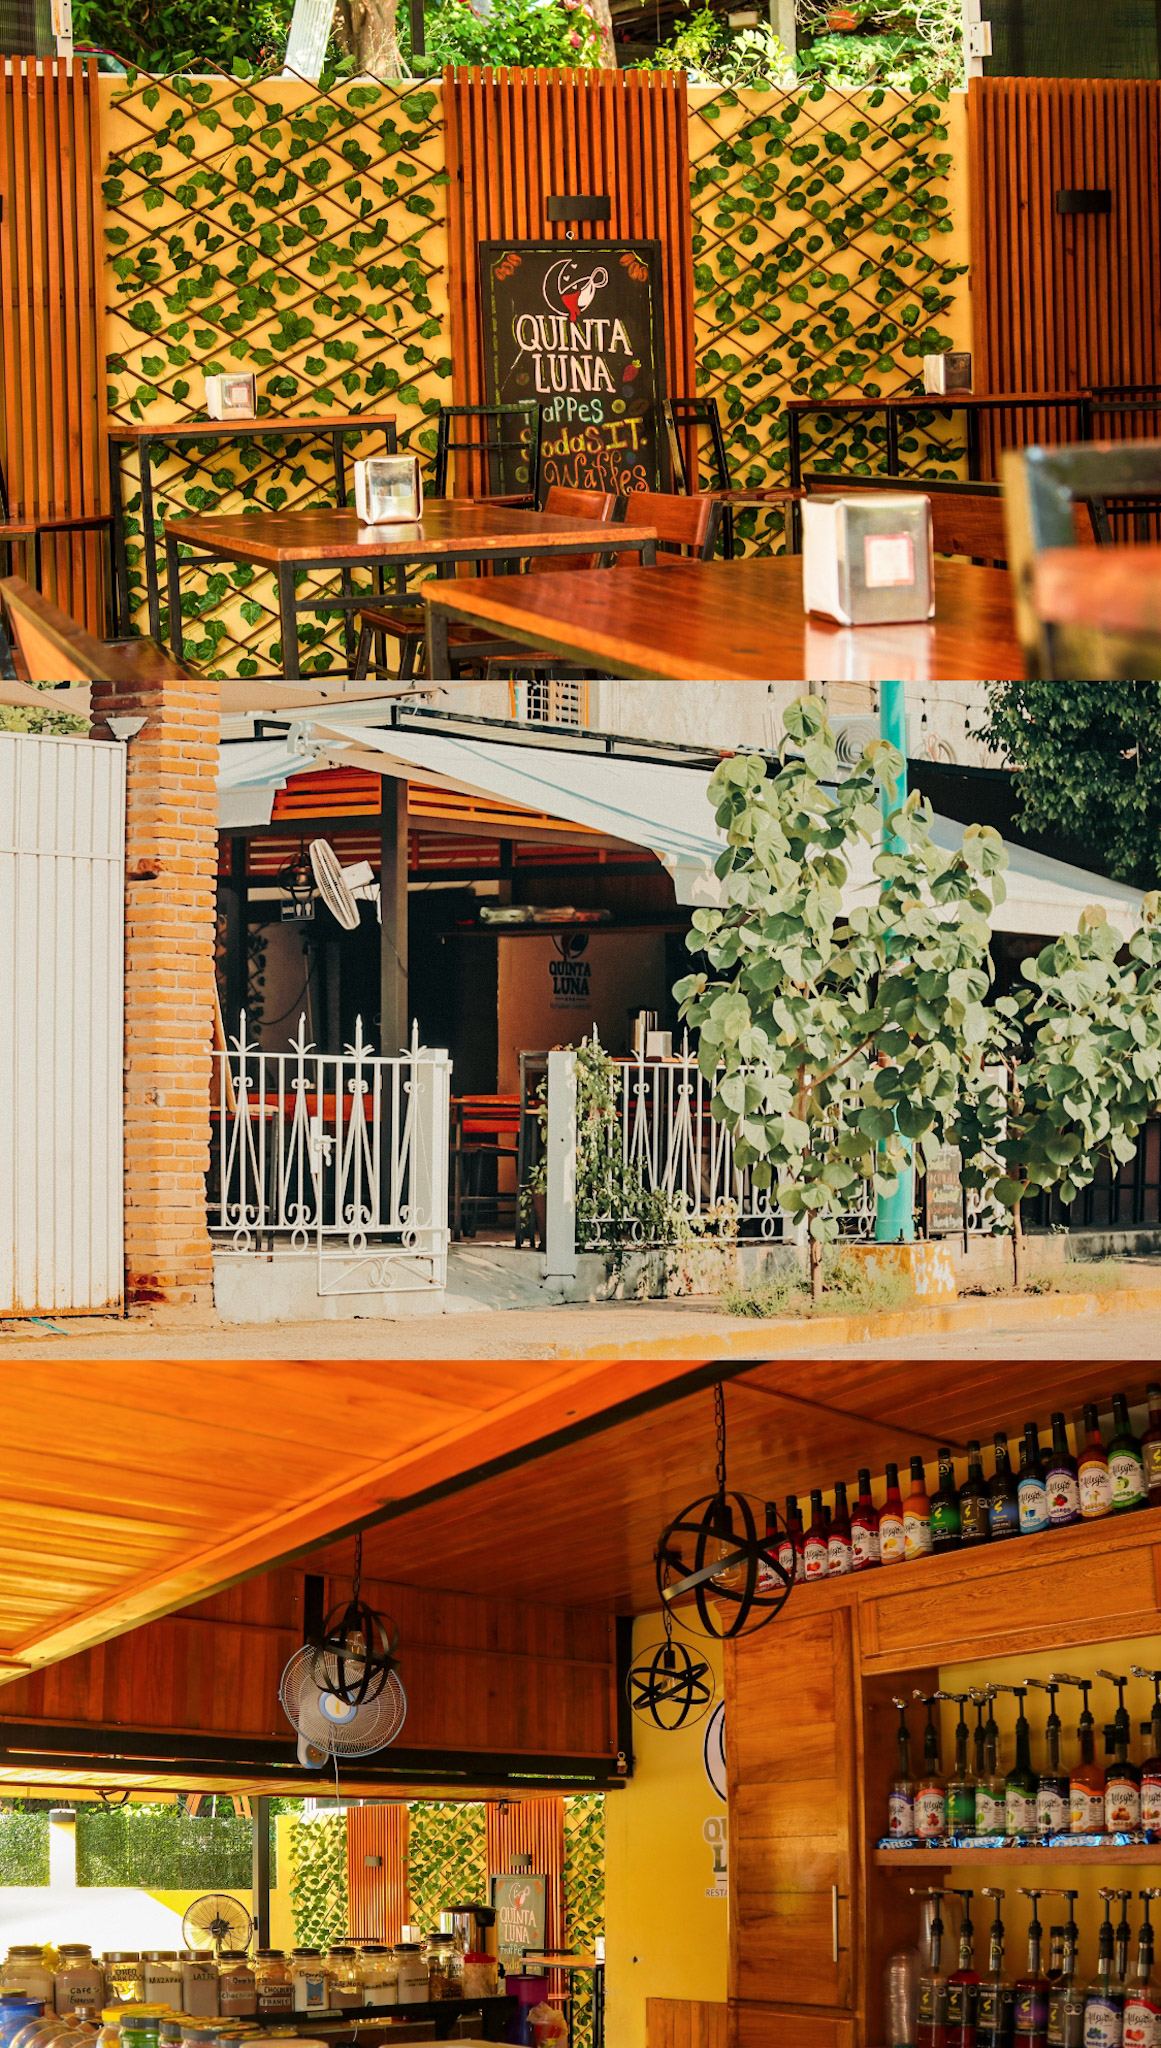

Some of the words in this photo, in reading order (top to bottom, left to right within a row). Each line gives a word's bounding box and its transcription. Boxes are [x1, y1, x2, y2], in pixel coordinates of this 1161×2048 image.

[516, 314, 633, 356] QUINTA
[532, 354, 616, 393] LUNA
[549, 961, 591, 976] QUINTA
[553, 977, 590, 995] LUNA
[879, 1839, 914, 1850] OREO
[961, 1836, 999, 1849] OREO
[500, 1907, 537, 1927] QUINTA
[504, 1924, 530, 1943] LUNA
